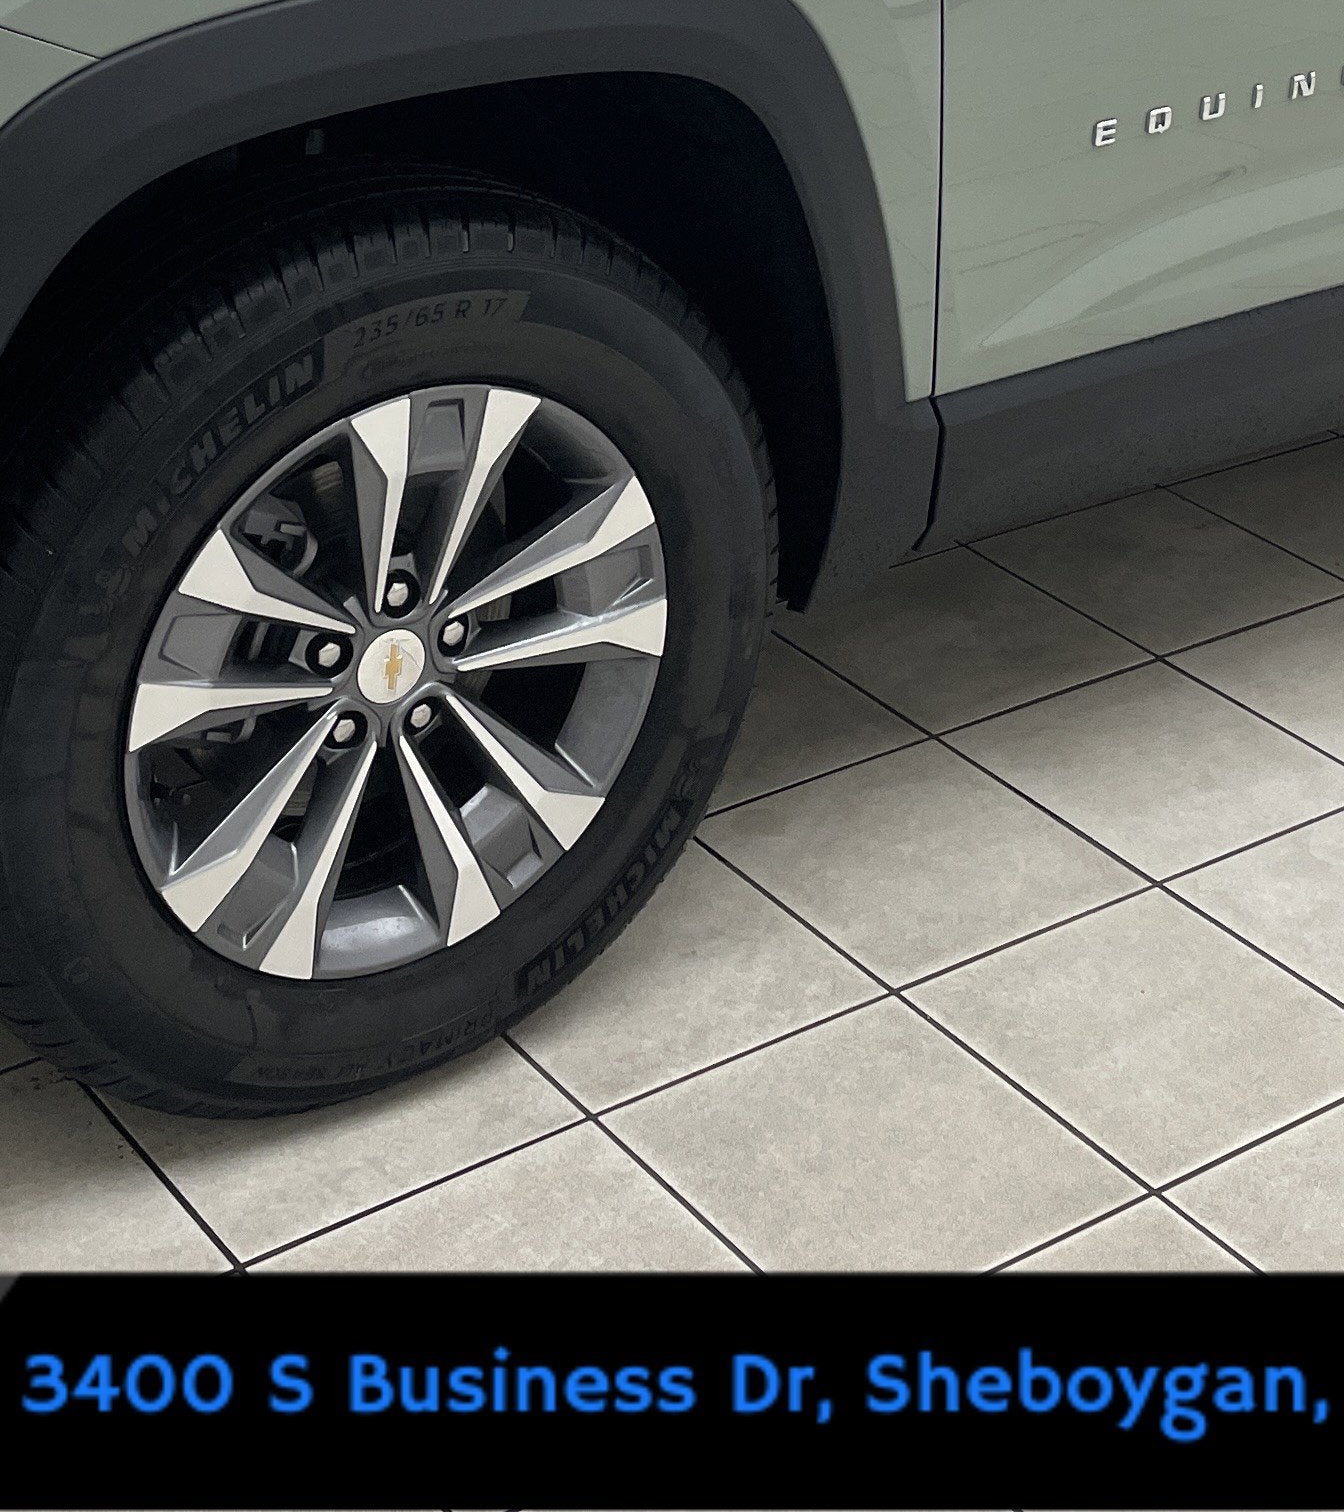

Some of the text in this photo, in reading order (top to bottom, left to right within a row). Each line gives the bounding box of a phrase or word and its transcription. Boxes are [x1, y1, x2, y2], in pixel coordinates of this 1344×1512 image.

[353, 298, 509, 349] 235/65 R 17
[121, 354, 314, 557] MICHELIN
[528, 807, 682, 996] MICHELIN
